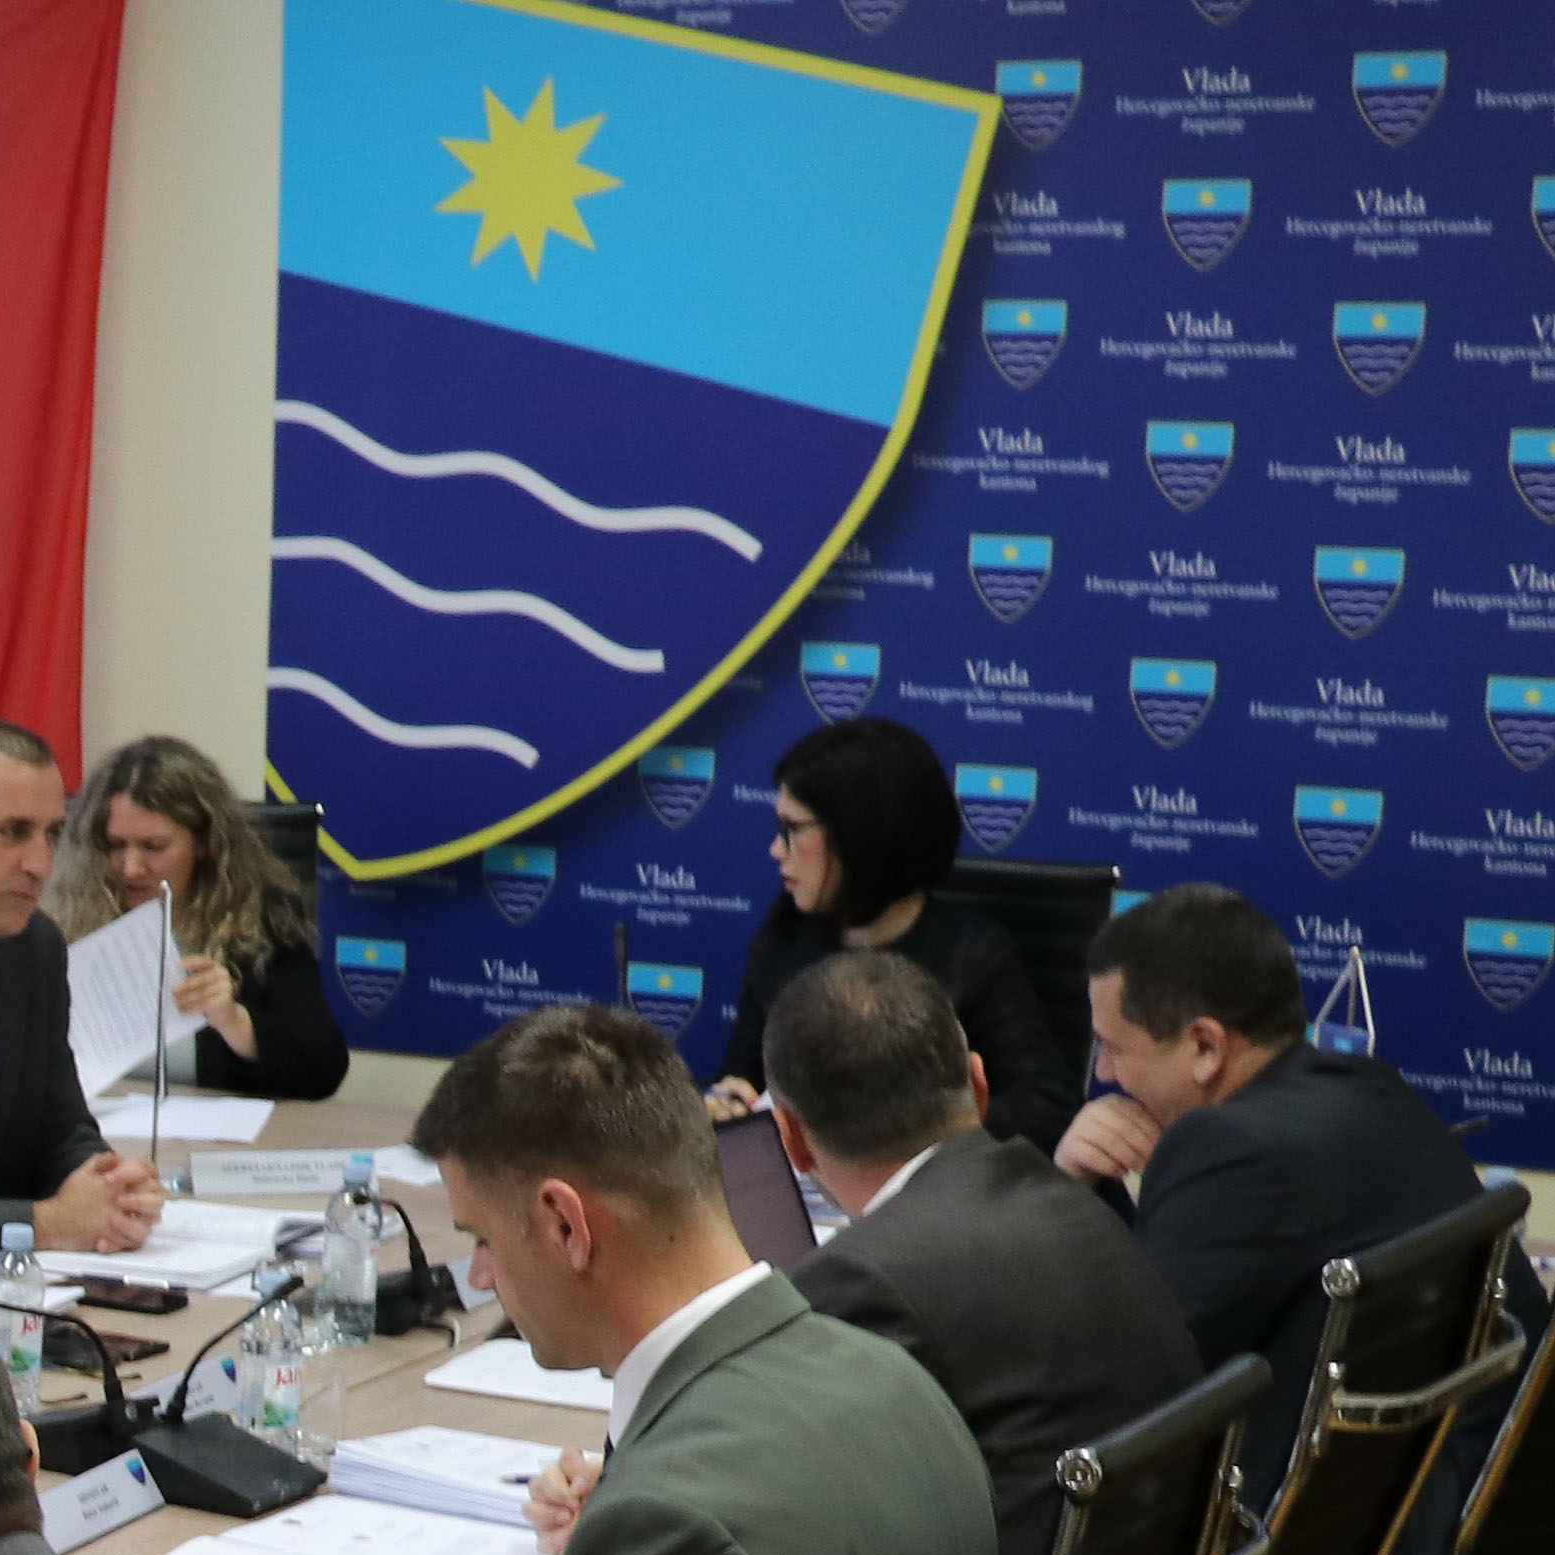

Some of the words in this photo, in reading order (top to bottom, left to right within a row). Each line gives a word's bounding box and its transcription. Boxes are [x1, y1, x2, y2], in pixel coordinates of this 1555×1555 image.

[1182, 65, 1252, 93] Vlada
[992, 190, 1058, 217] Vlada
[1354, 187, 1427, 216] Vlada
[1165, 310, 1234, 339] Vlada
[979, 426, 1043, 455] Vlada
[1335, 435, 1406, 464] Vlada
[1149, 550, 1217, 579] Vlada
[965, 658, 1029, 688] Vlada
[1316, 677, 1385, 707] Vlada
[1132, 785, 1198, 815] Vlada
[636, 862, 697, 891] Vlada
[1296, 914, 1363, 945] Vlada
[482, 958, 539, 986] Vlada
[1463, 1047, 1533, 1079] Vlada
